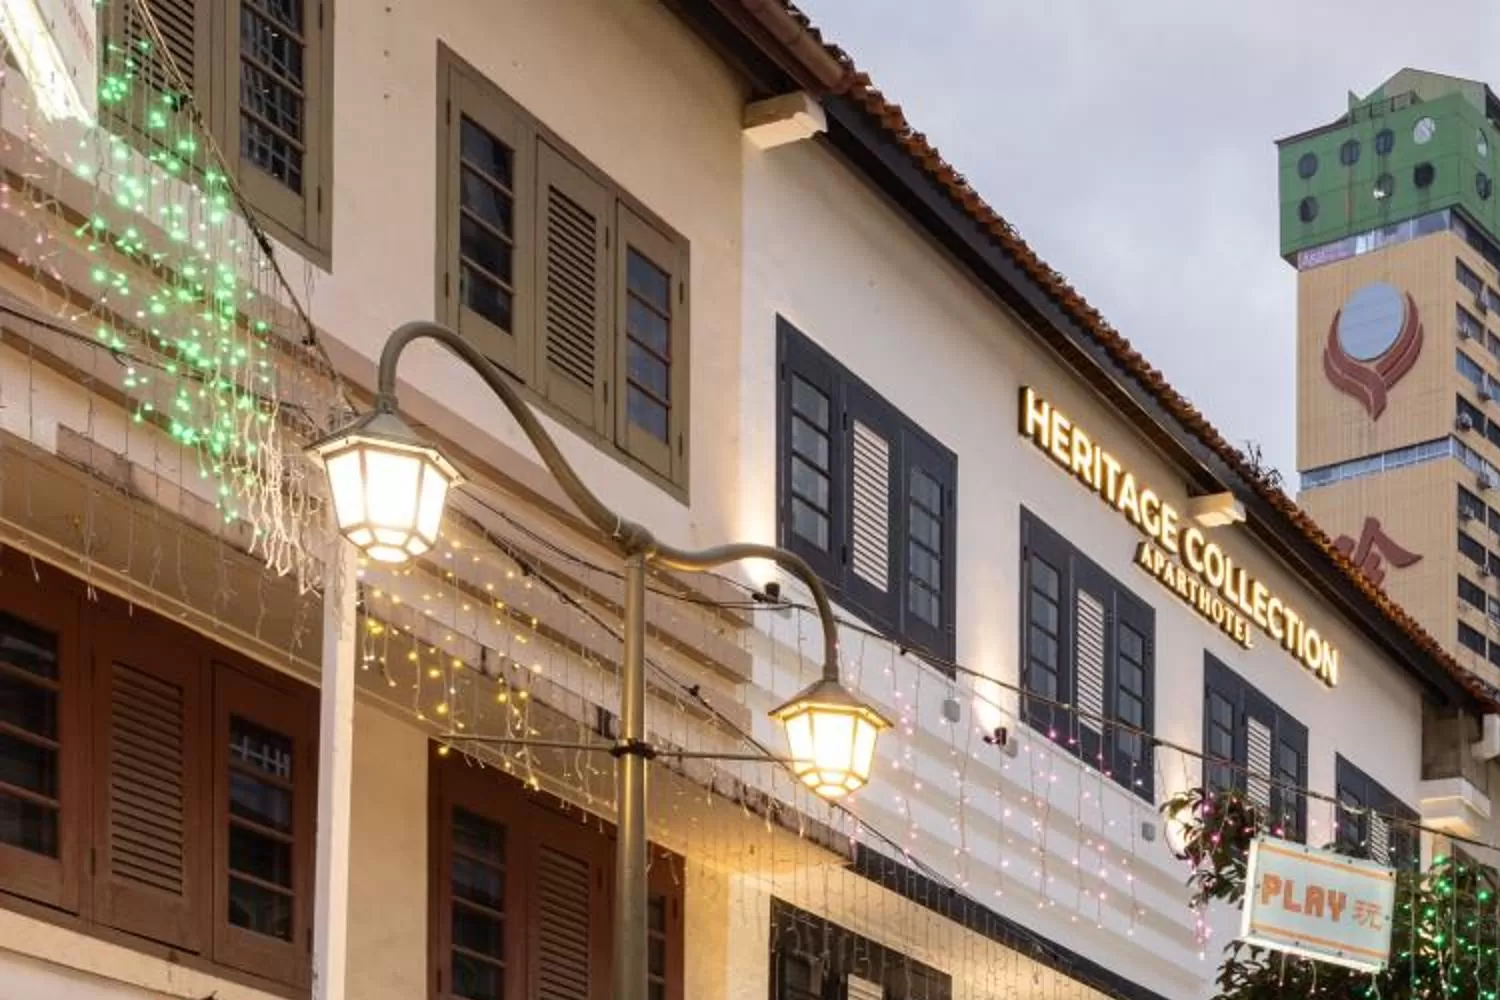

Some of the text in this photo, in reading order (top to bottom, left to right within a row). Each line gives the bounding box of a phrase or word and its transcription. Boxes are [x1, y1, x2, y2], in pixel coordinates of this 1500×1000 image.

[1019, 385, 1340, 687] HERITAGE COLLECTION
[1135, 541, 1253, 650] APARTHOTEL
[1261, 873, 1347, 923] PLAY
[1352, 898, 1383, 931] 玩
